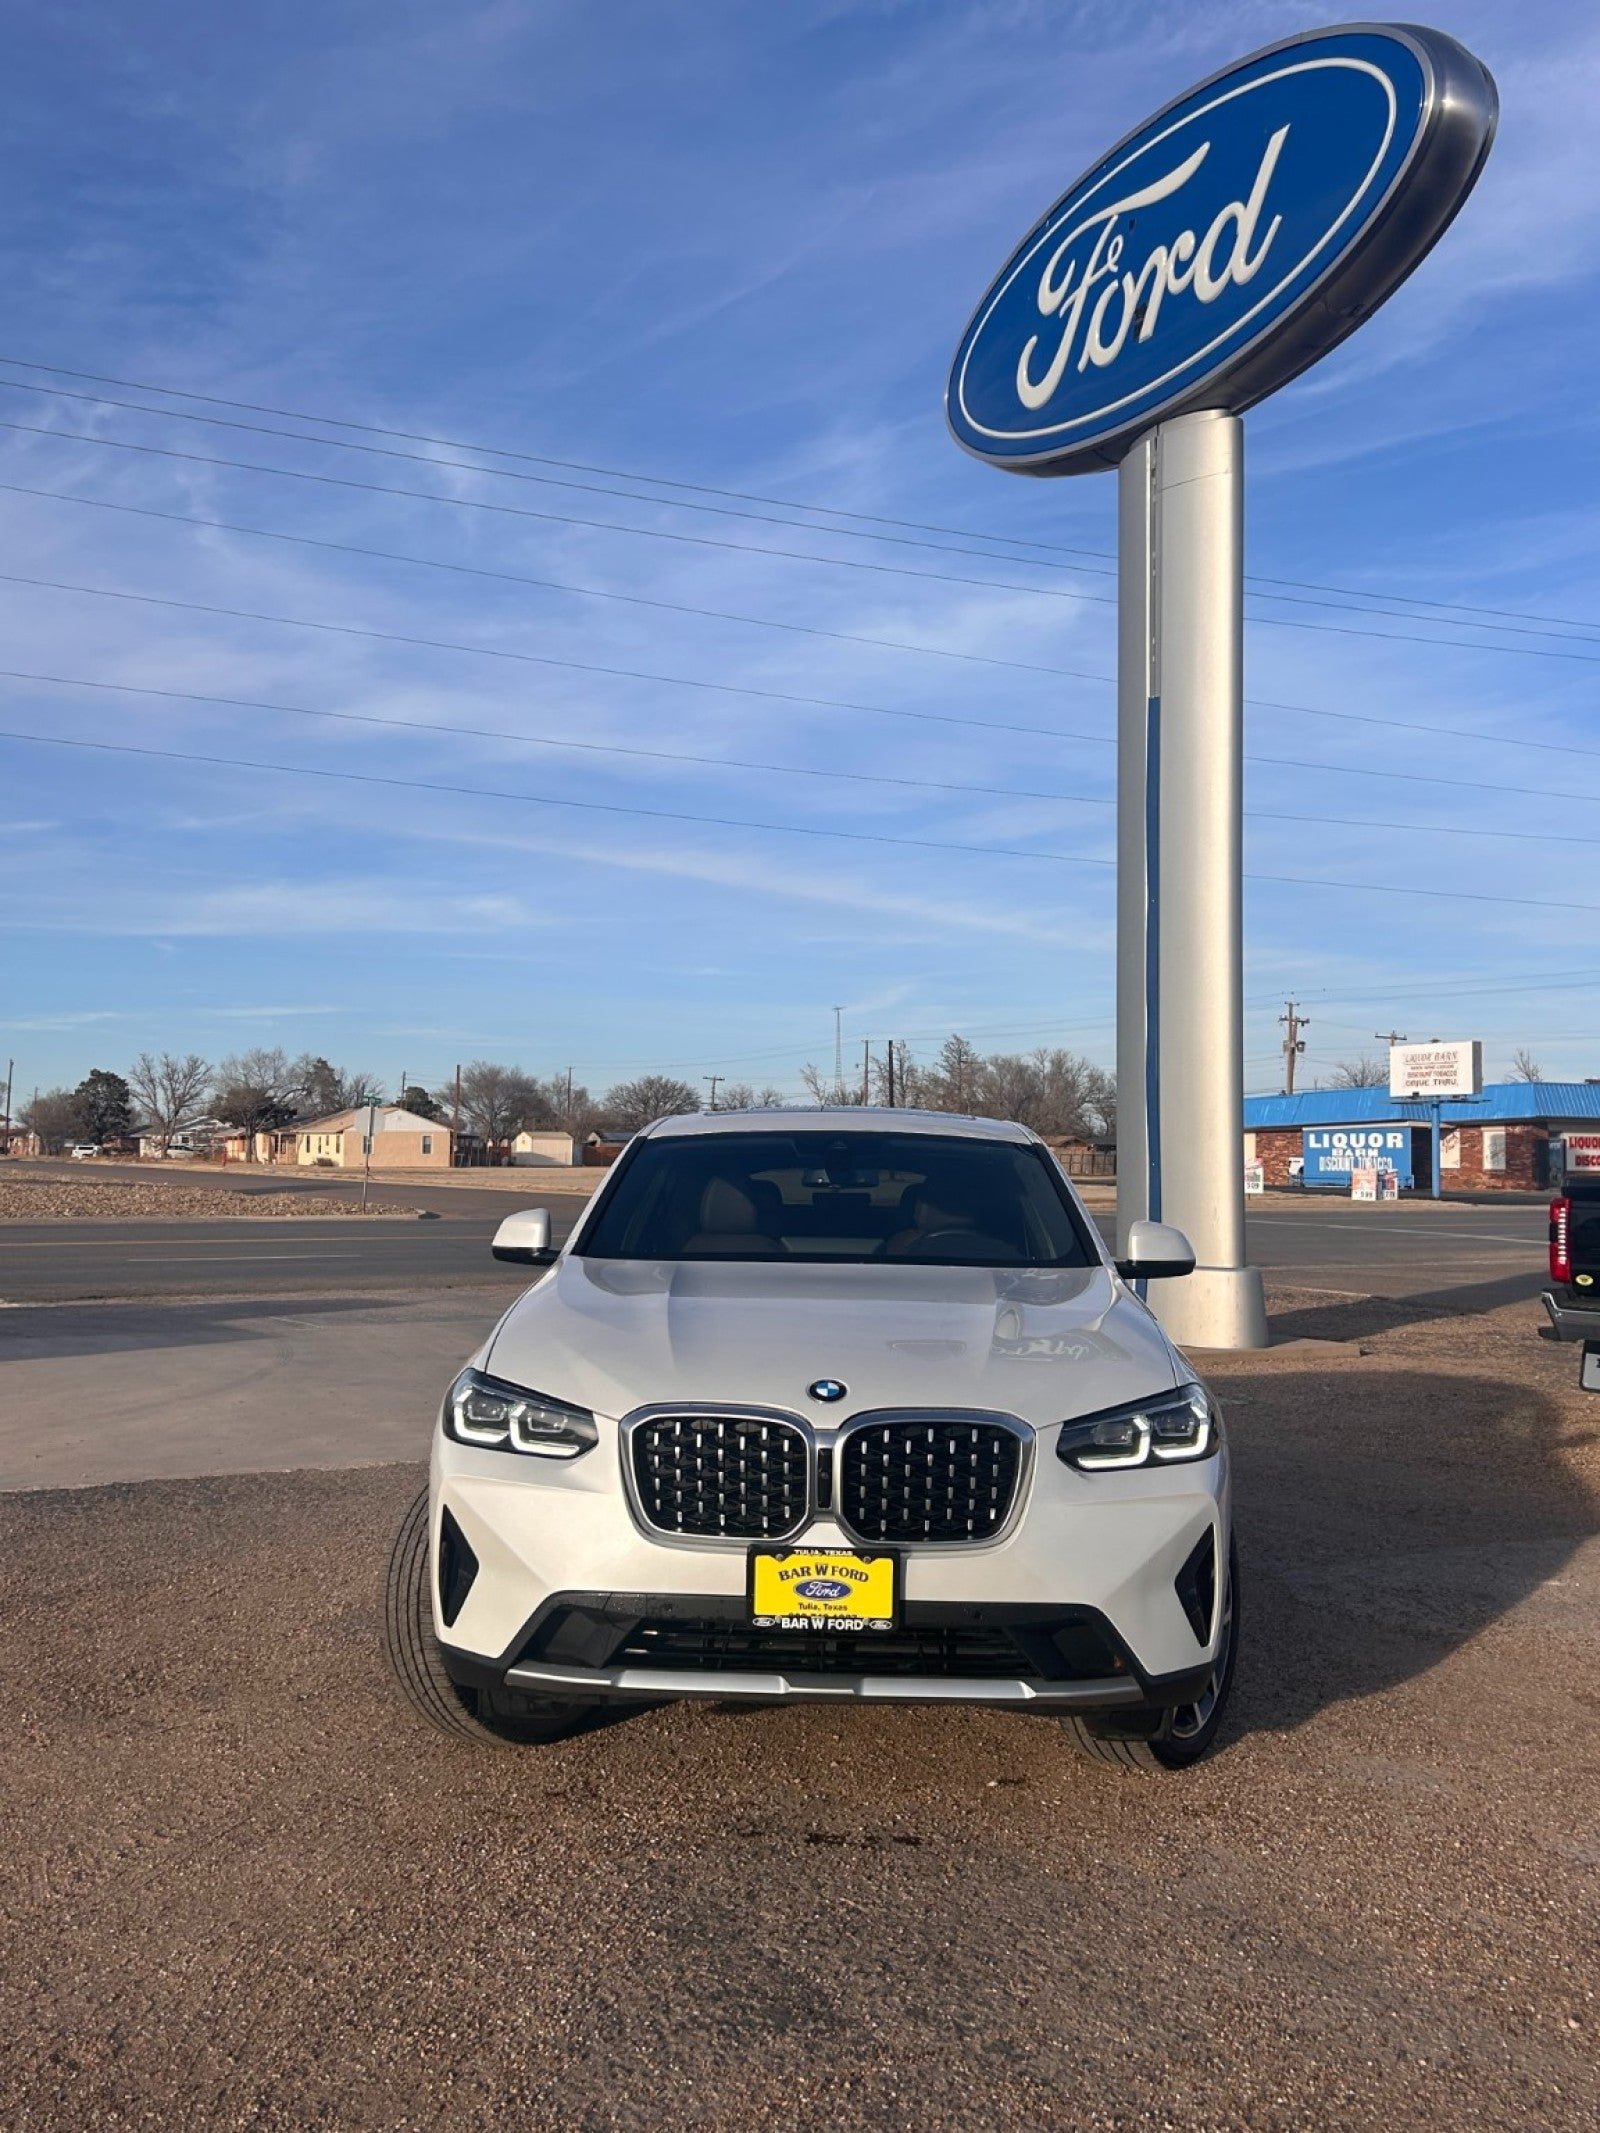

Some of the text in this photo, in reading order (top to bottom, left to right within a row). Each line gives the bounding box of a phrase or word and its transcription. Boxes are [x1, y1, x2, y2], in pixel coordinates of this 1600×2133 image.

[1016, 123, 1290, 410] Ford
[1308, 1132, 1404, 1149] LIQUOR
[1568, 1136, 1600, 1150] LIQUO
[1331, 1149, 1379, 1157] BARN
[1319, 1156, 1354, 1172] DISCOUNT
[778, 1563, 870, 1583] BAR W FORD
[804, 1580, 840, 1598] Ford
[798, 1602, 848, 1612] Tulia, Texas
[781, 1616, 864, 1631] BAR W FORD
